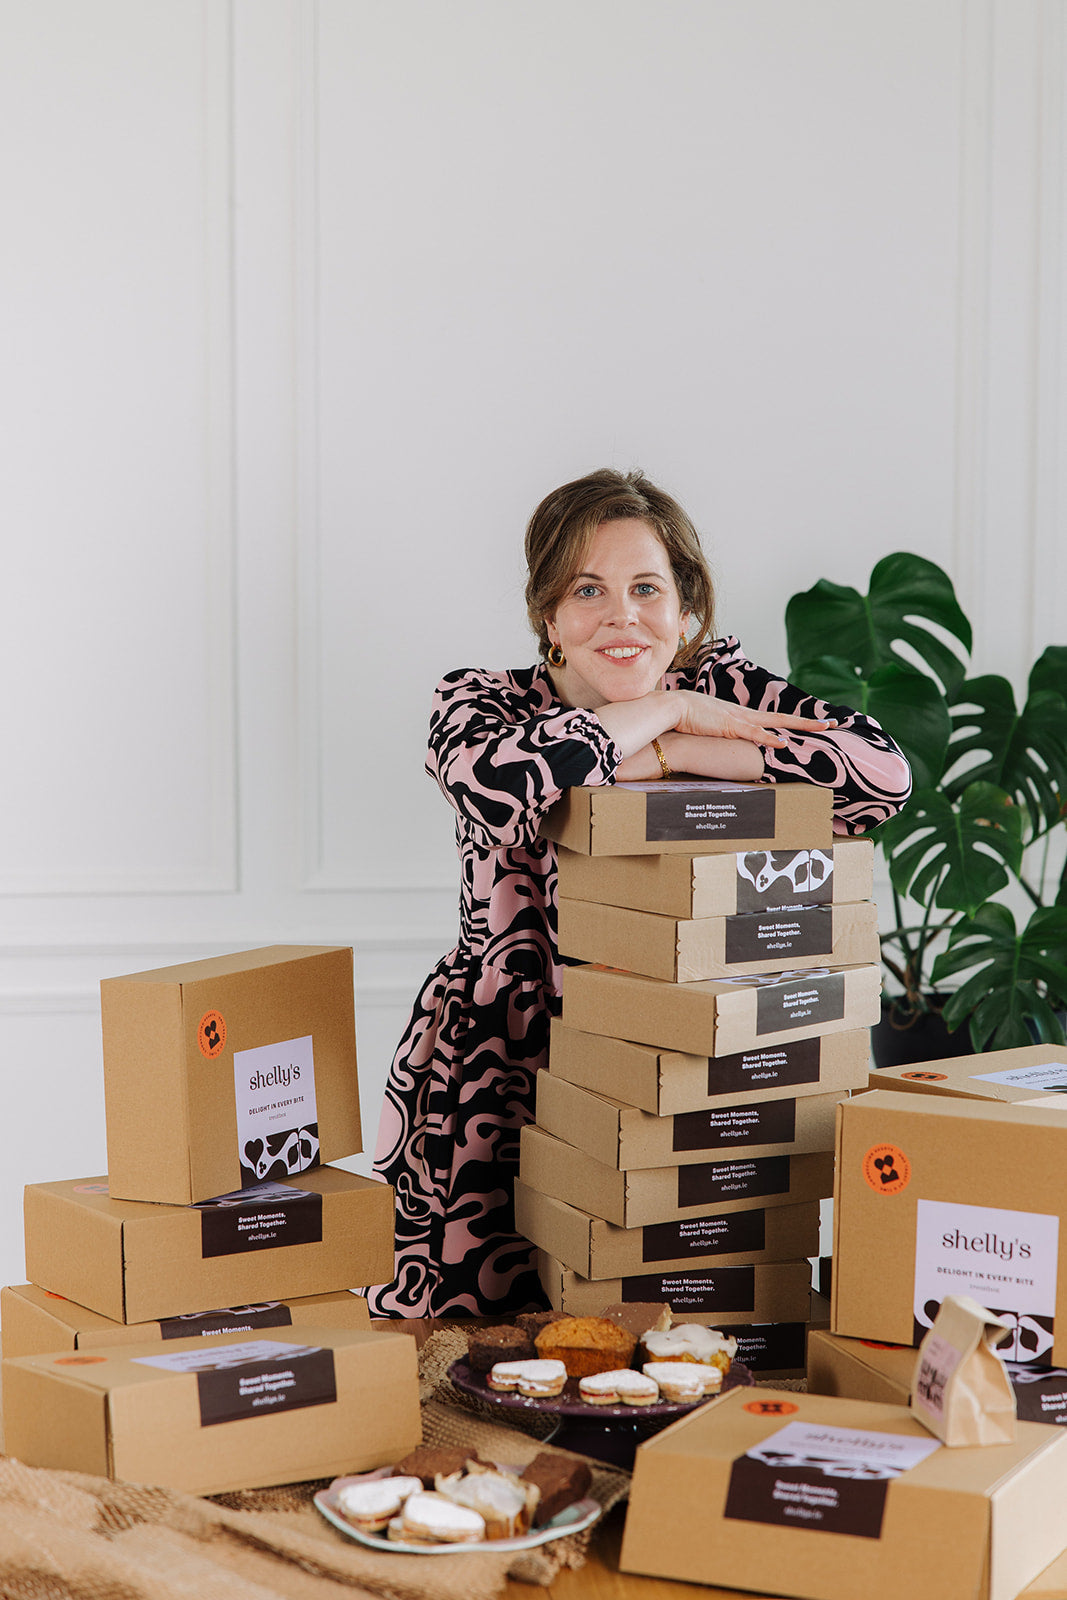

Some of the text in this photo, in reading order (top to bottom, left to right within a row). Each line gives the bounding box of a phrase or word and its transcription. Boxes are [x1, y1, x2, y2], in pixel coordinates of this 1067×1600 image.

[249, 1064, 300, 1090] shelly's
[249, 1104, 270, 1115] DELIGHT
[278, 1099, 292, 1108] EVERY
[712, 1170, 758, 1181] Shared Together.
[260, 1220, 287, 1228] Together.
[701, 1227, 729, 1235] Together.
[942, 1229, 1031, 1261] shelly's
[937, 1266, 972, 1277] DELIGHT
[987, 1274, 1012, 1283] EVERY
[1016, 1278, 1034, 1286] BITE
